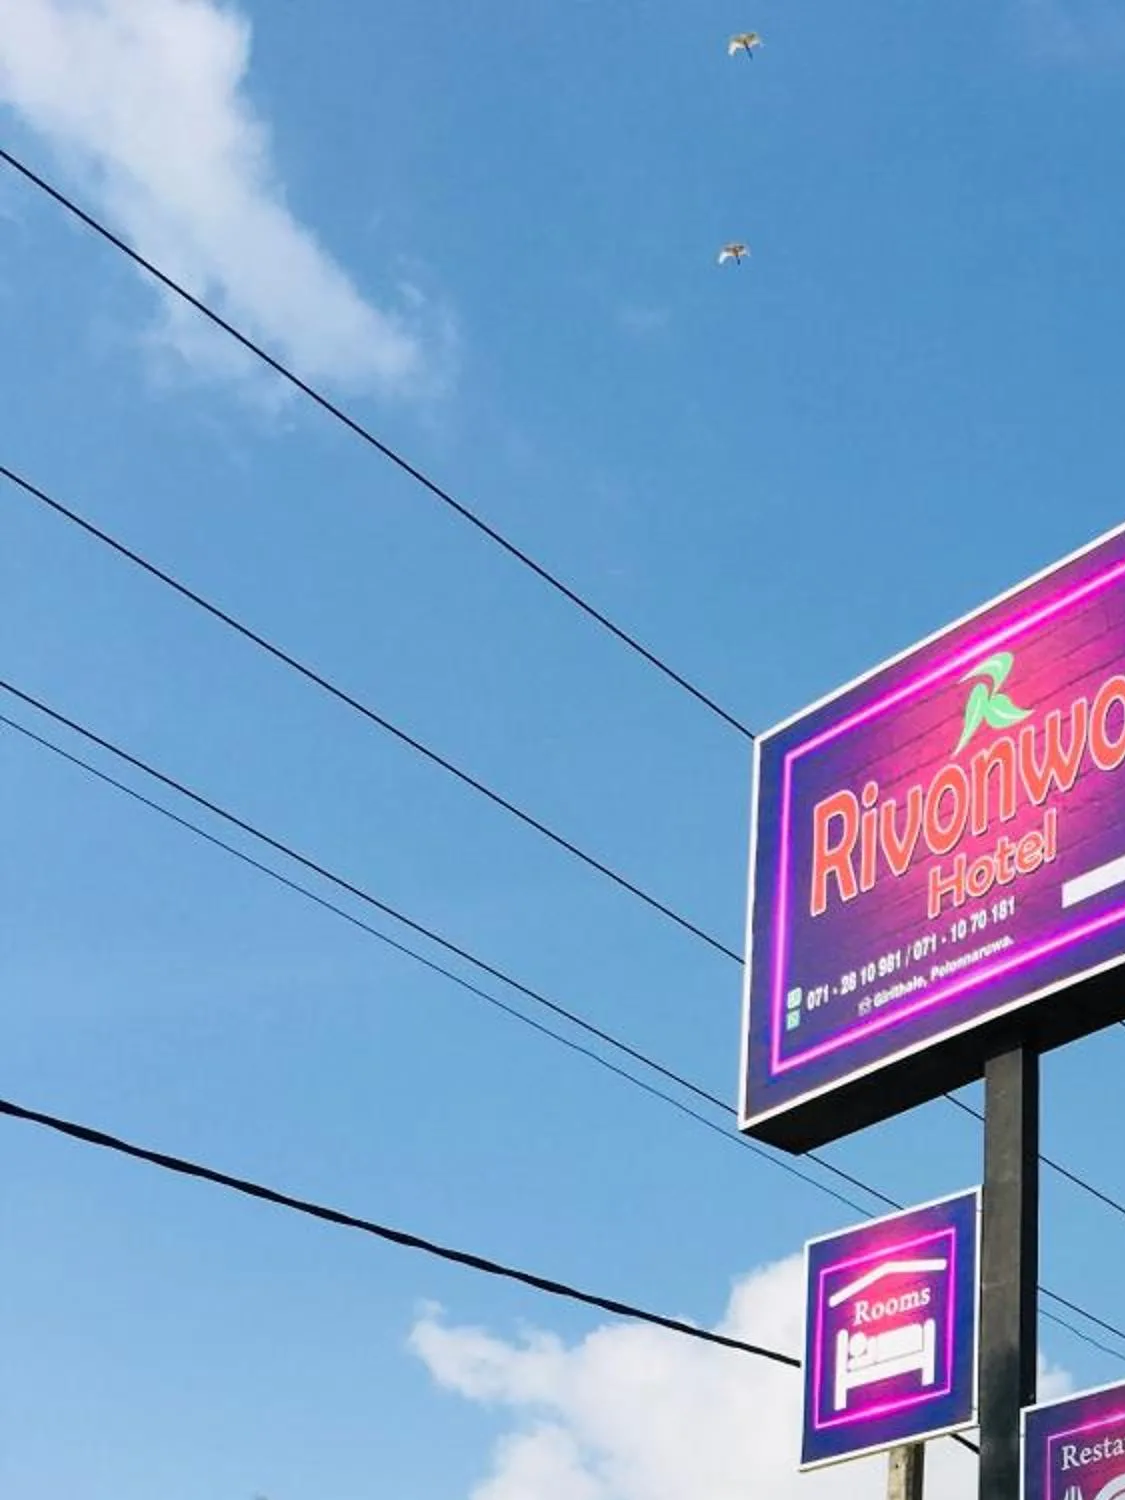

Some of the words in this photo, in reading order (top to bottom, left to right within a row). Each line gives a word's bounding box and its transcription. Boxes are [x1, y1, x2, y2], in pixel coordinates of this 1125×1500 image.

[928, 808, 1057, 919] Hotel
[807, 984, 829, 1011] 071
[861, 963, 876, 987] 10
[913, 933, 937, 961] 071
[951, 919, 967, 943] 10
[970, 909, 987, 934] 70
[991, 895, 1015, 924] 181
[853, 1286, 931, 1326] Rooms
